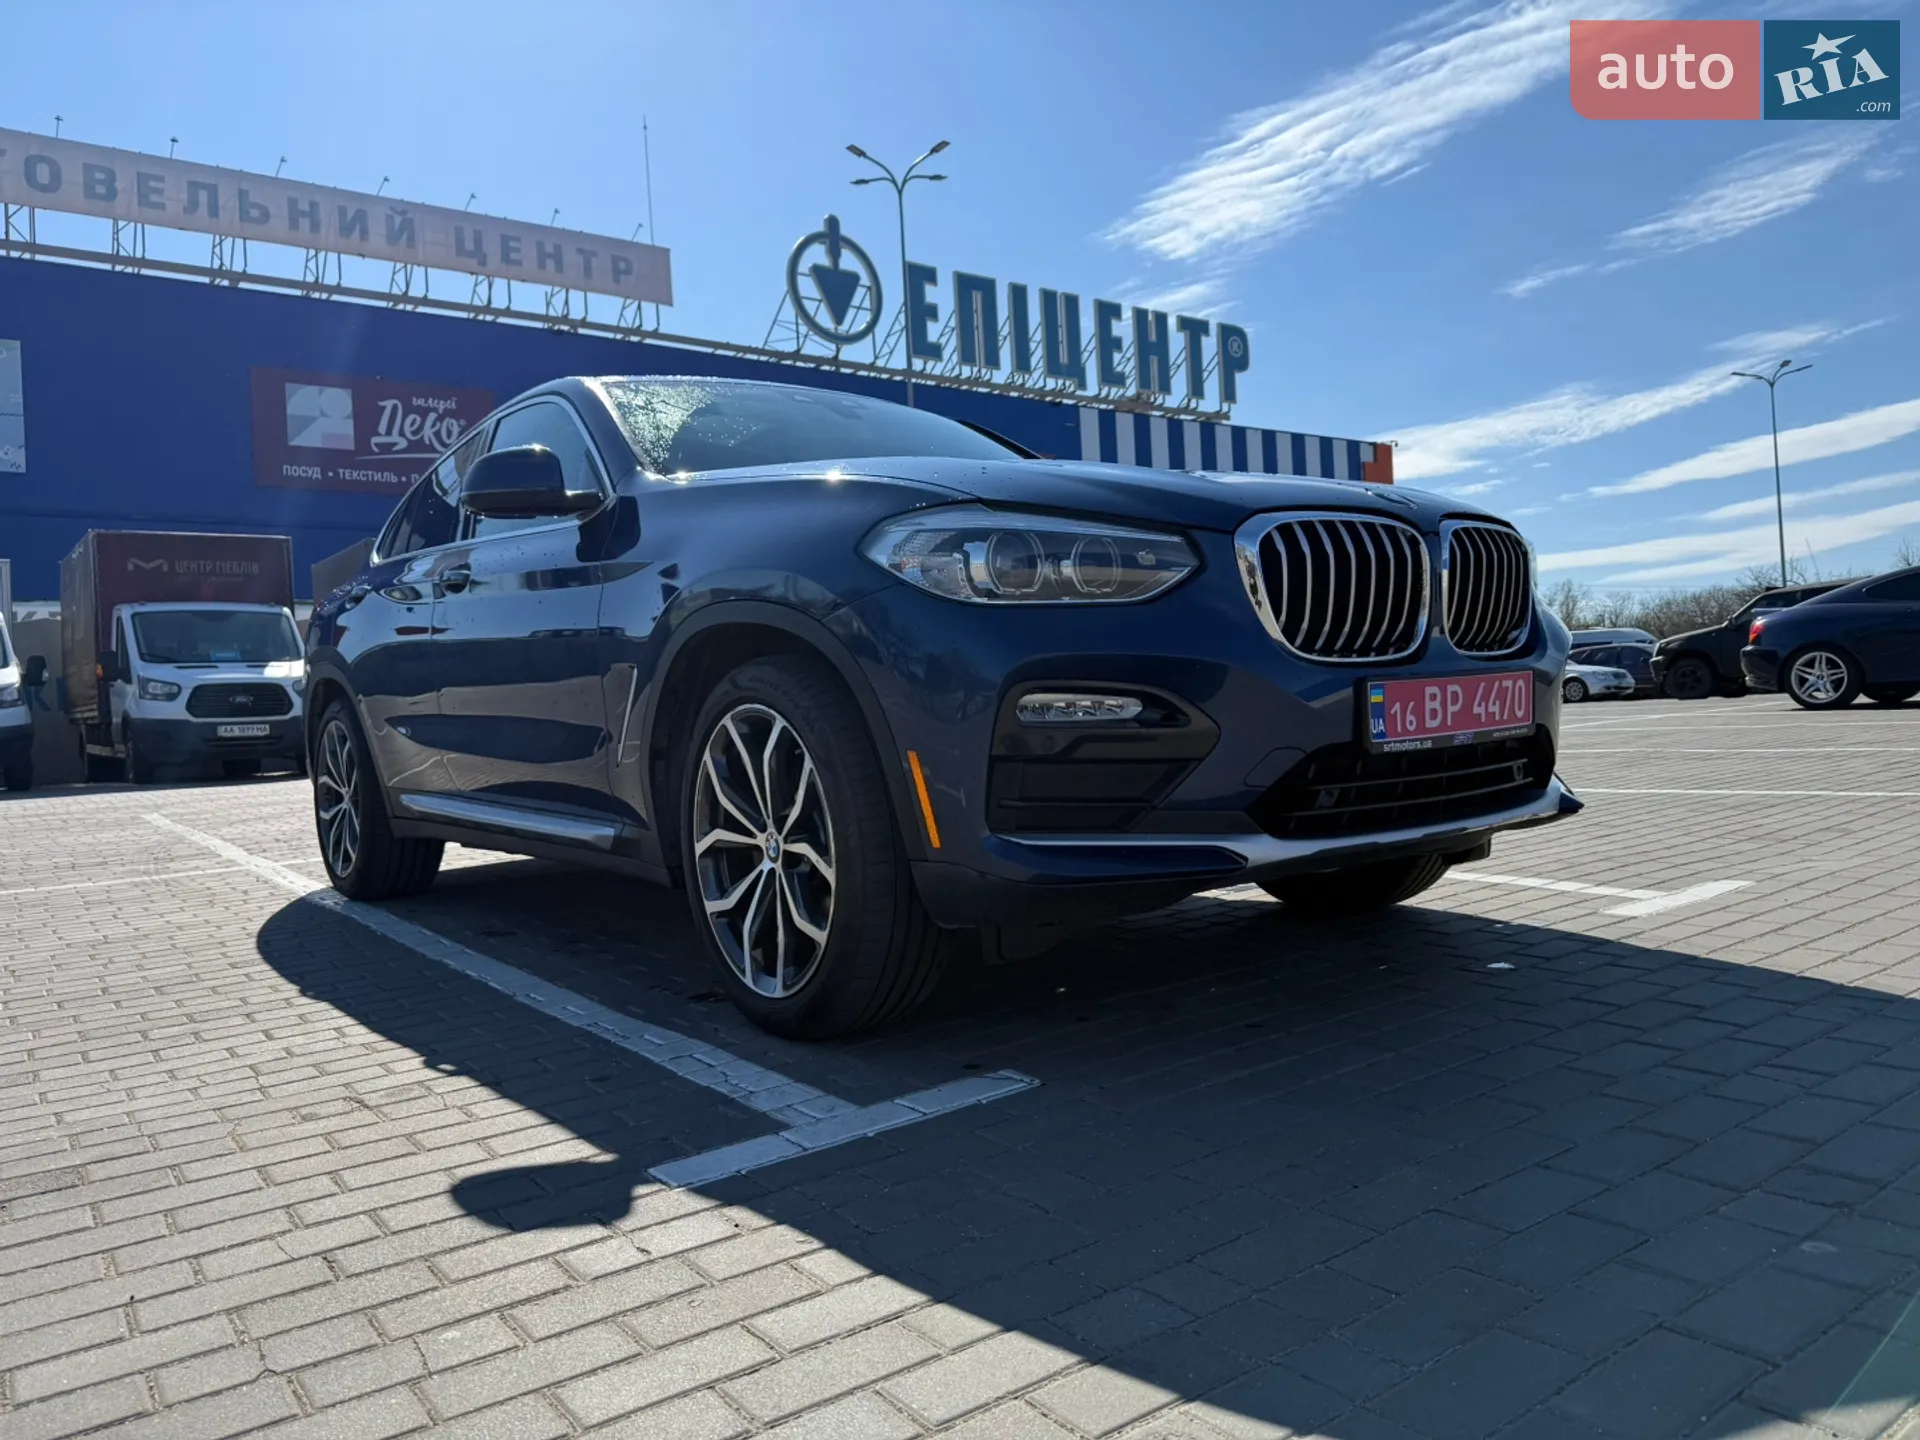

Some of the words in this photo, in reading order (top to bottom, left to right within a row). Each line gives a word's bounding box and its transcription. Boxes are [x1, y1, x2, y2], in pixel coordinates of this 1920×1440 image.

[0, 148, 416, 250] ОВЕЛЬНИЙ
[454, 224, 635, 285] ЦЕНТР
[283, 464, 322, 480] ПОСУД
[337, 468, 398, 483] ТЕКСТИЛЬ
[1371, 717, 1386, 733] UA
[1390, 701, 1417, 733] 16
[1472, 679, 1526, 723] 4470
